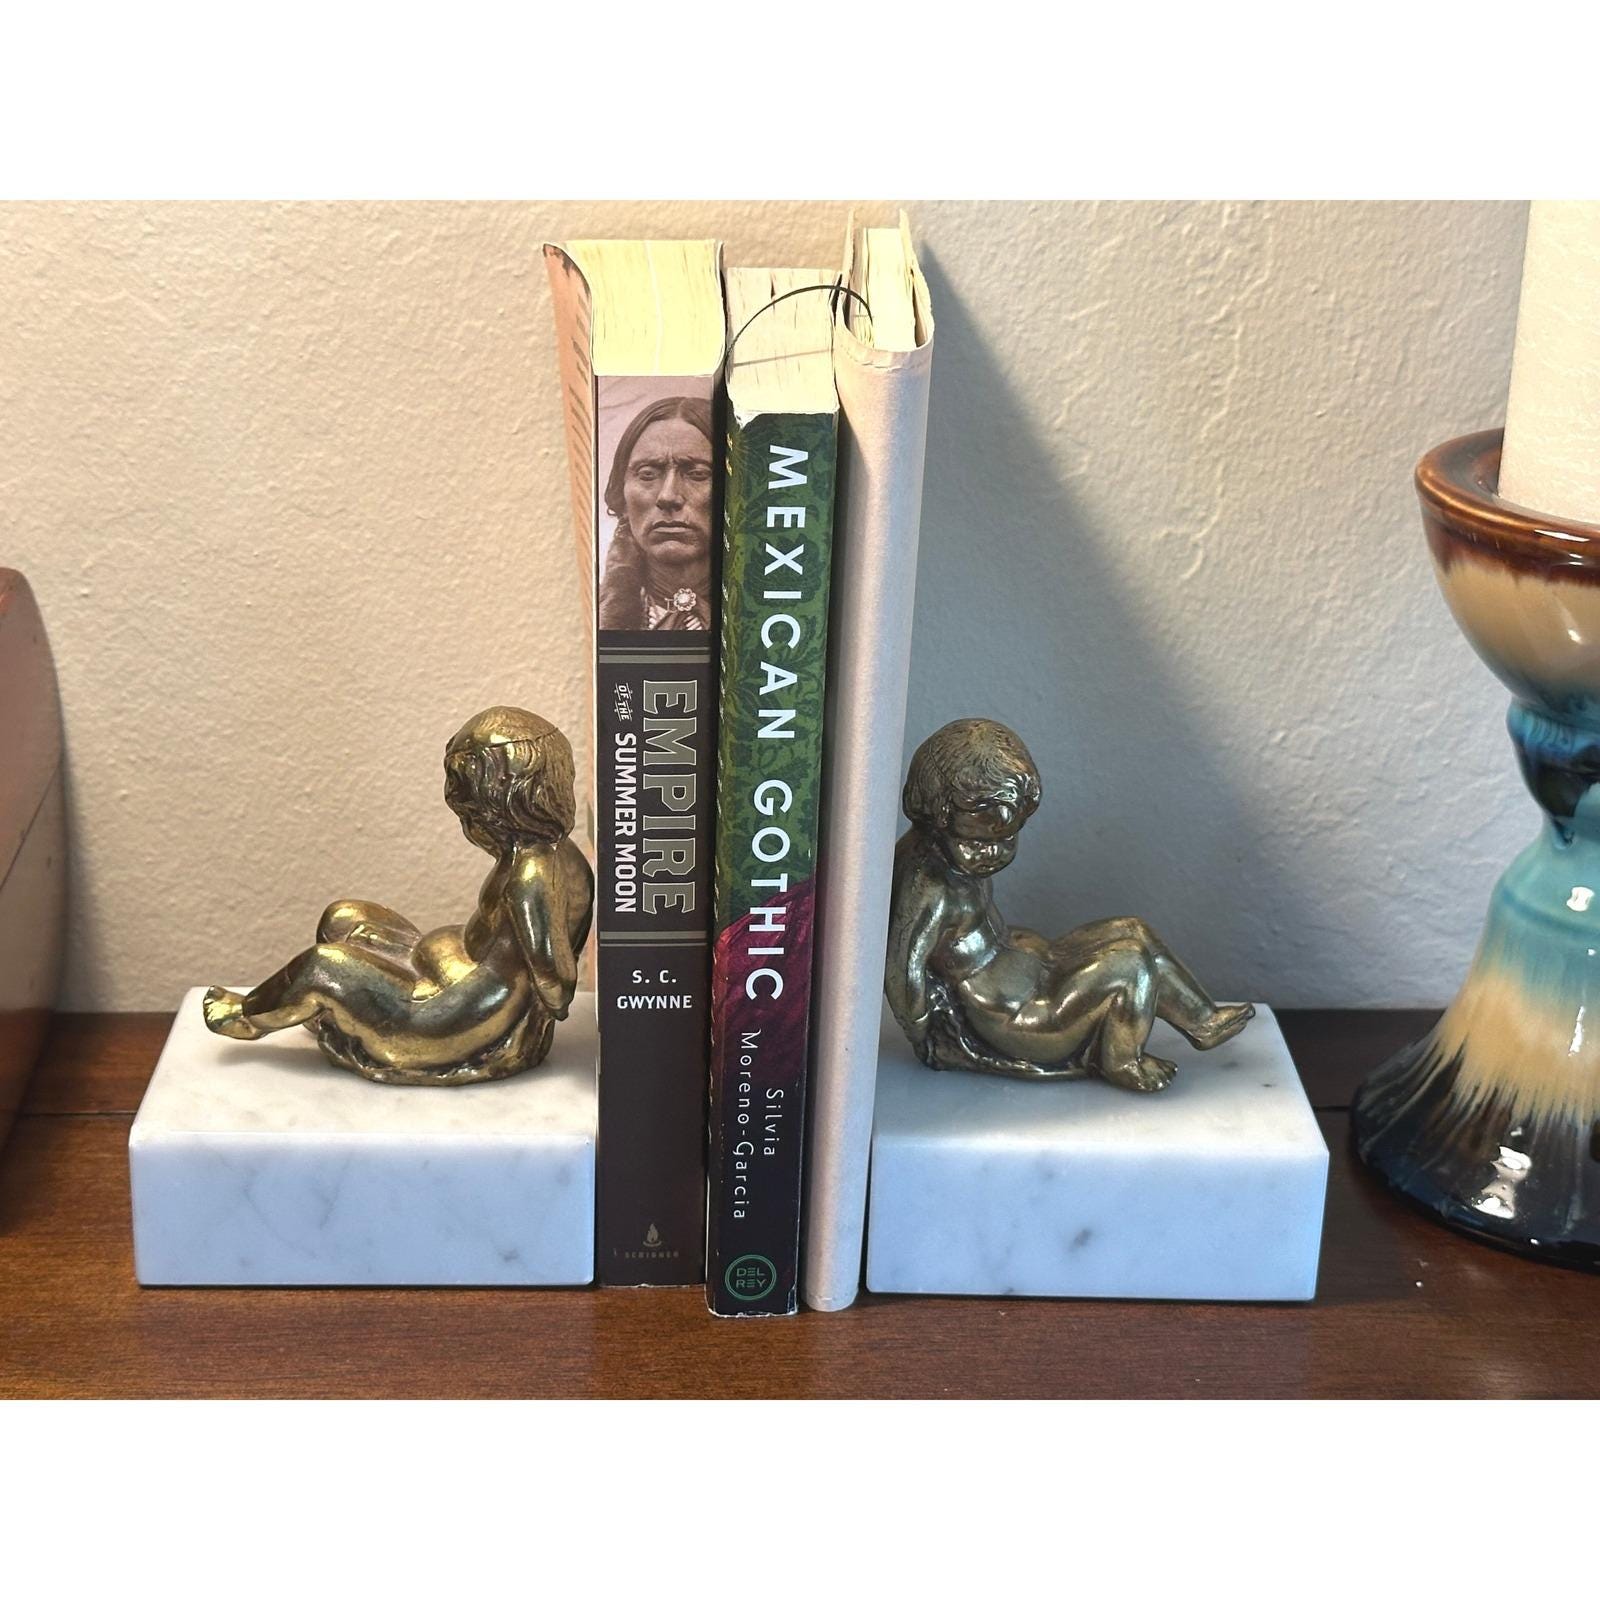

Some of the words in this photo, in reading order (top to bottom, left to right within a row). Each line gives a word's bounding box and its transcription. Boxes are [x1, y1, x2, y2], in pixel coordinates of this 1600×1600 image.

[757, 444, 809, 739] MEXICAN
[617, 701, 630, 720] THE
[618, 685, 629, 699] OF
[615, 732, 637, 836] SUMMER
[642, 679, 697, 915] EMPIRE
[615, 843, 637, 913] MOON
[746, 779, 793, 1000] GOTHIC
[616, 995, 693, 1010] GWYNNE
[632, 970, 650, 984] S.
[659, 970, 677, 984] C.
[732, 1028, 762, 1219] Moreno-Garcia
[763, 1087, 784, 1157] Silvia
[735, 1279, 767, 1288] REY
[736, 1267, 766, 1277] DEL
